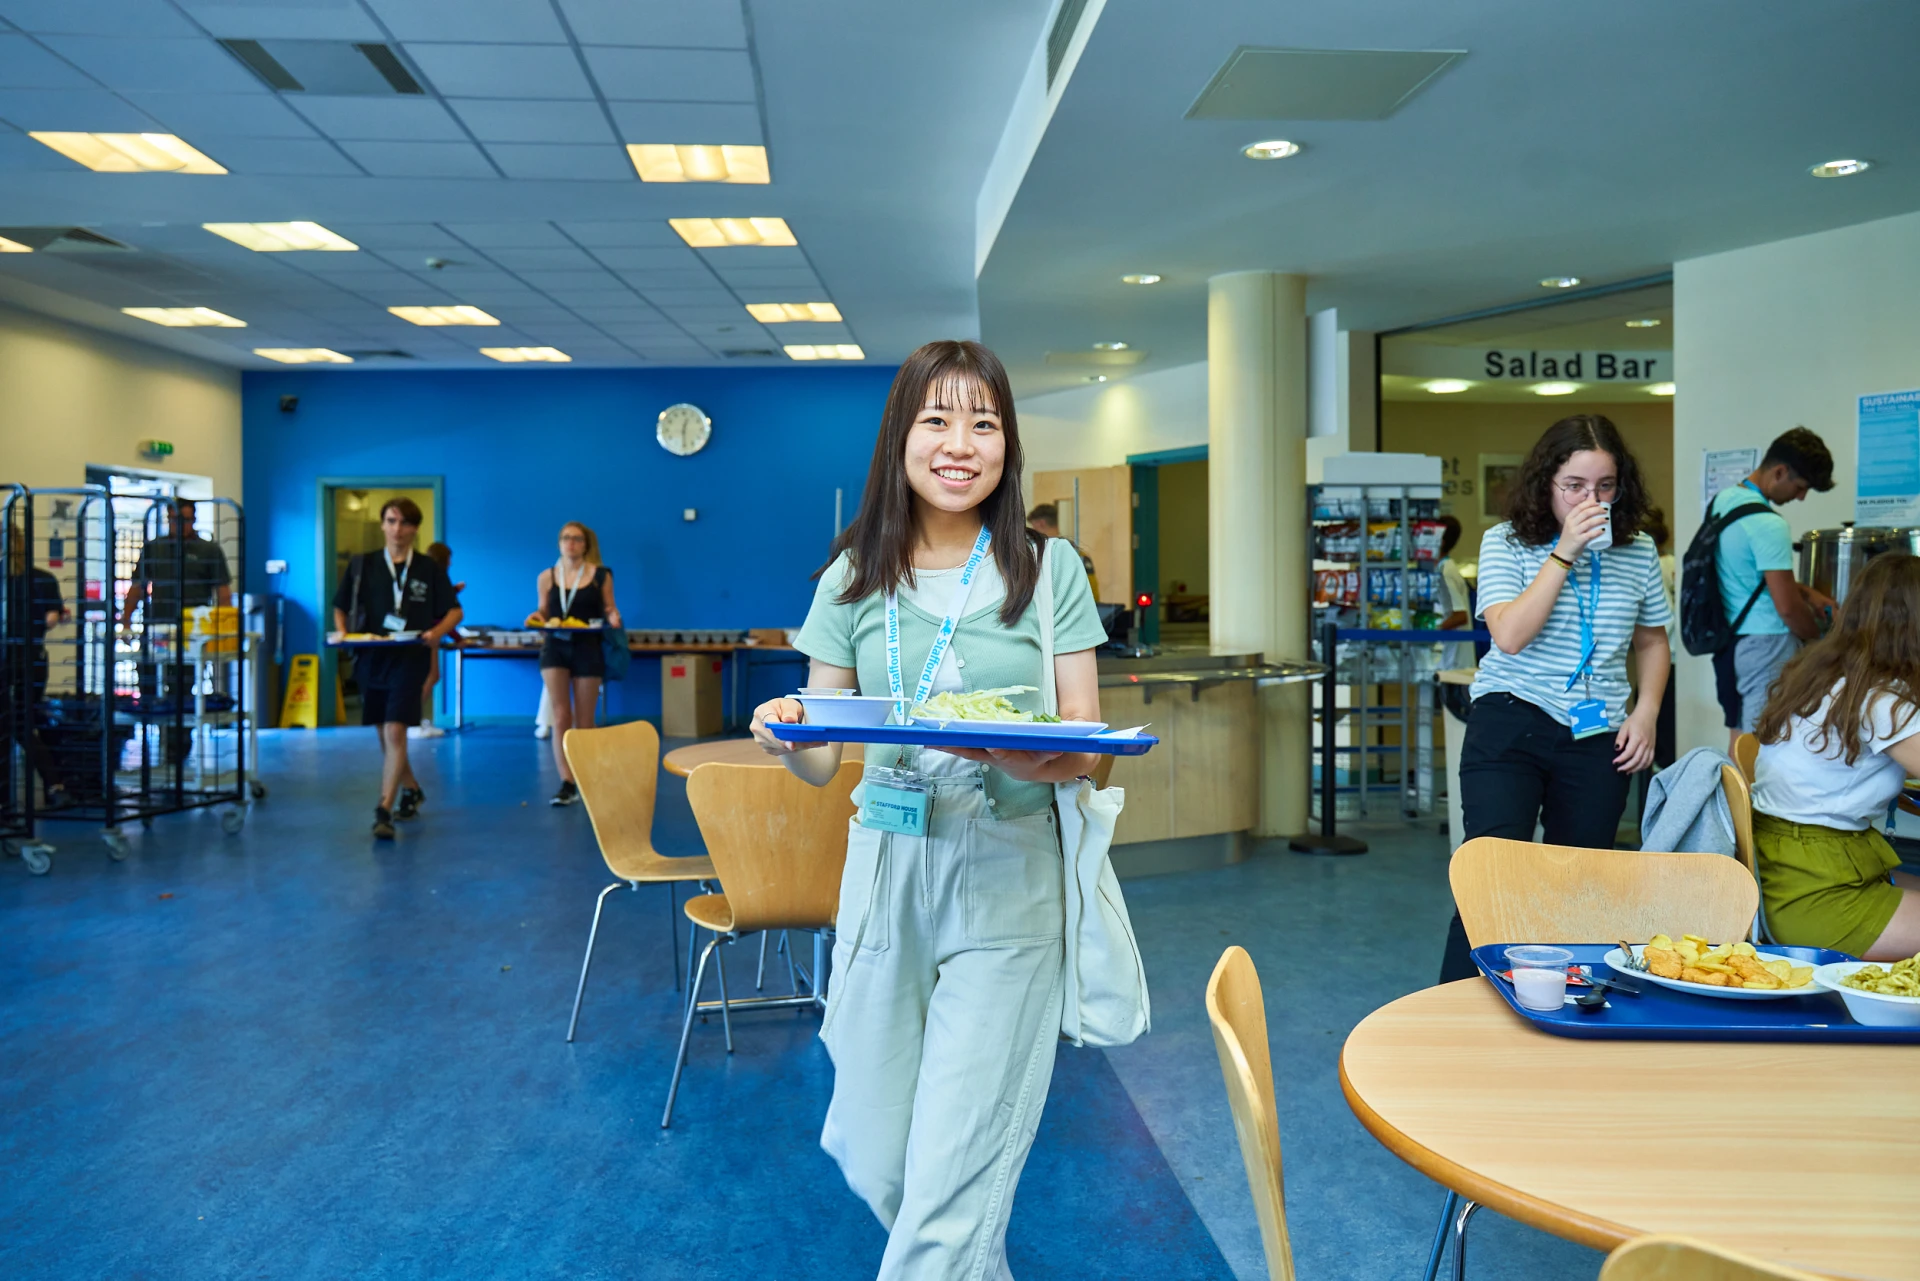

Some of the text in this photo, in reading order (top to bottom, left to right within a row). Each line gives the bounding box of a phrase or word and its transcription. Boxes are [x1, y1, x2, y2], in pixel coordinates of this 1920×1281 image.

[1485, 351, 1657, 379] Salad Bar
[960, 553, 983, 585] House
[888, 608, 902, 693] Stafford House
[921, 637, 948, 683] Stafford
[876, 801, 901, 810] STAFFORD
